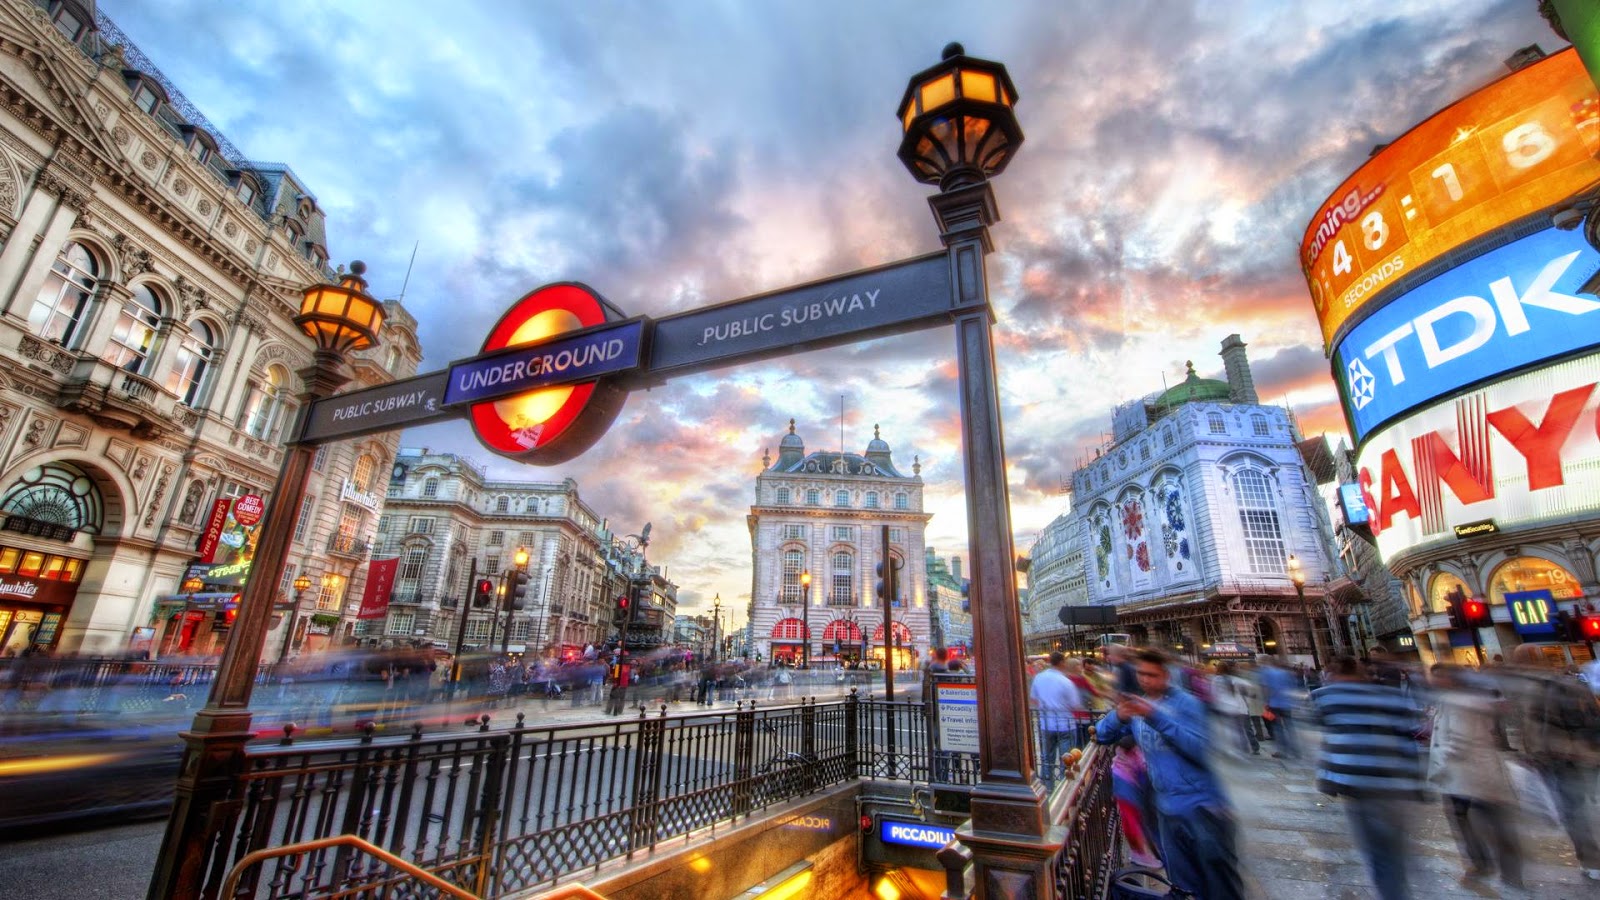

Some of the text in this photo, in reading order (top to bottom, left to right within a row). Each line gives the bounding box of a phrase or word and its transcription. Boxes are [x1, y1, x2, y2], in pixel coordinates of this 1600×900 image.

[1344, 255, 1405, 308] SECONDS
[702, 289, 881, 345] PUBLIC SUBWAY
[1365, 250, 1600, 386] TDK
[459, 338, 624, 392] UNDERGROUND
[333, 390, 426, 421] PUBLIC SUBWAY
[1359, 381, 1600, 537] SANY
[237, 503, 262, 515] COMEDY
[245, 496, 260, 506] BEST
[208, 528, 219, 541] 39
[374, 564, 387, 603] SALE
[1514, 599, 1549, 625] GAP
[1400, 637, 1412, 645] GAP
